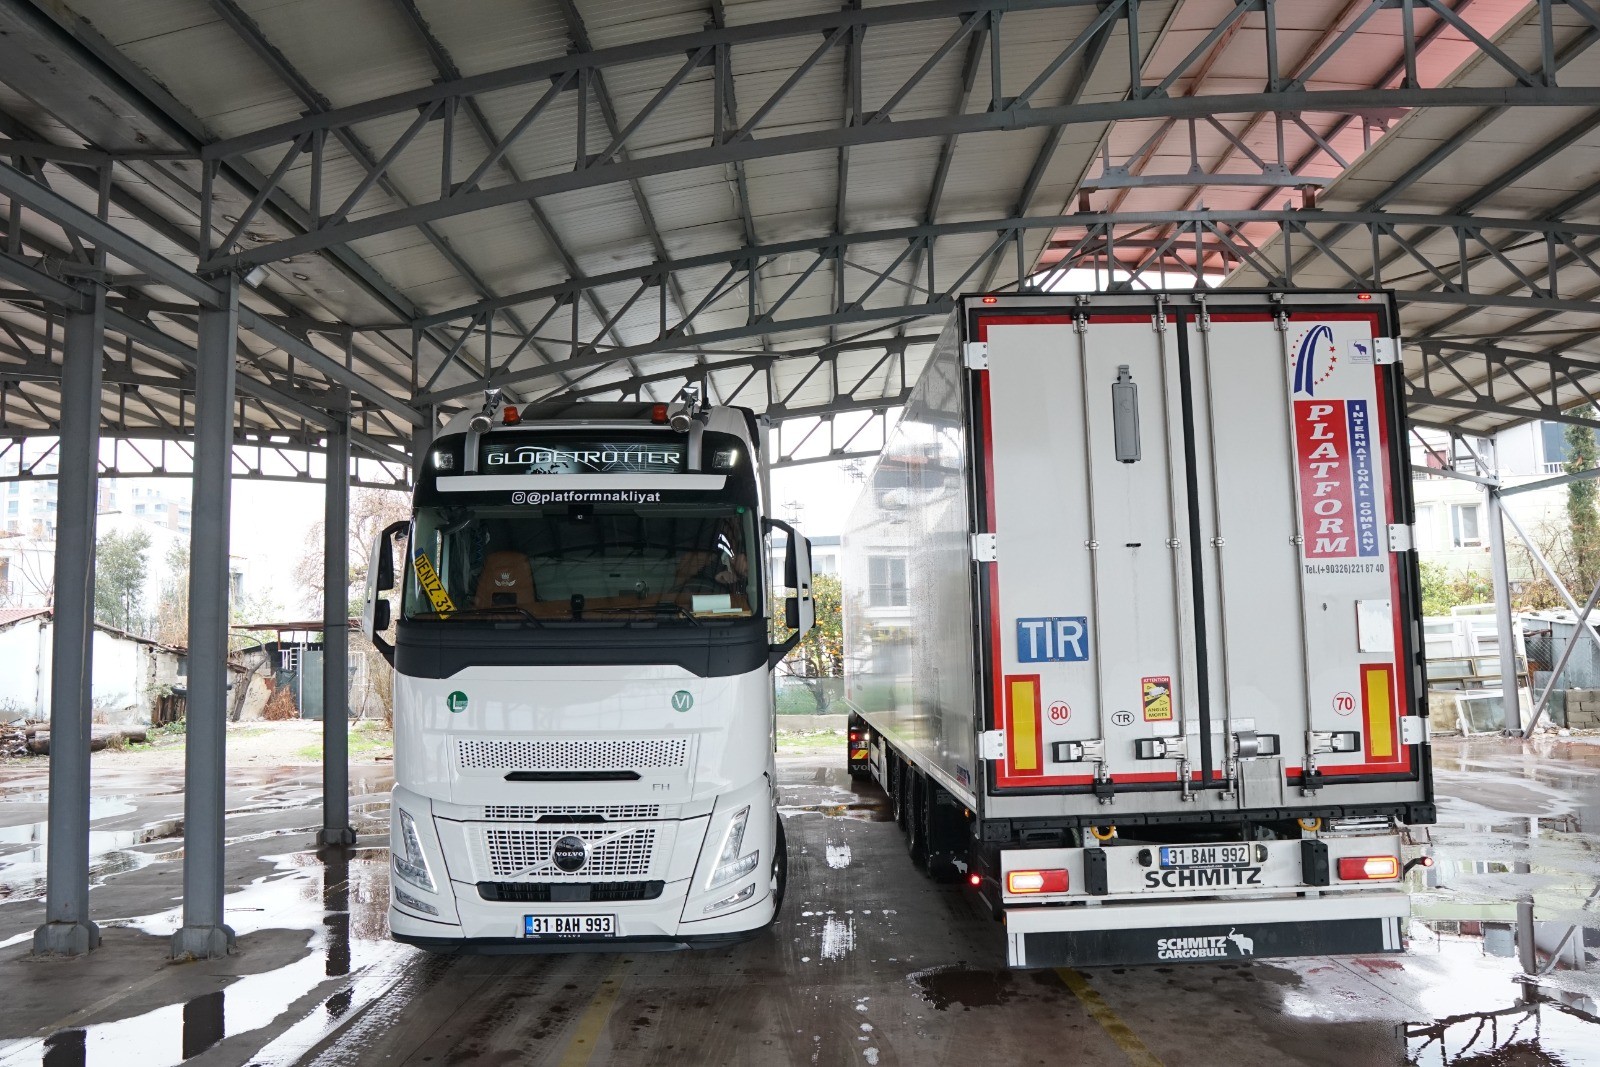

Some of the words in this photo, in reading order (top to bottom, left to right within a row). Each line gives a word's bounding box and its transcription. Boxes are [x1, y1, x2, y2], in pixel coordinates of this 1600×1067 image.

[487, 450, 680, 465] GLOBETROTTER
[1353, 405, 1369, 496] INTERNATIONAL
[1306, 404, 1349, 553] PLATFORM
[527, 491, 661, 504] @platformnakliyat
[1360, 502, 1375, 551] COMPANY
[415, 555, 442, 596] DENIZ
[1365, 564, 1374, 573] 87
[1375, 564, 1385, 573] 40
[1021, 620, 1083, 659] TIR
[675, 694, 690, 709] VI
[1336, 697, 1353, 711] 70
[1051, 706, 1069, 720] 80
[1116, 714, 1131, 723] TR
[652, 783, 670, 791] FH
[1169, 849, 1185, 865] 31
[1191, 847, 1216, 864] BAH
[1221, 847, 1246, 862] 992
[1145, 867, 1262, 888] SCHMITZ
[534, 918, 549, 932] 31
[555, 918, 580, 932] BAH
[585, 918, 610, 932] 993
[1157, 936, 1227, 951] SCHMITZ
[1157, 948, 1228, 959] CARGOBULL
